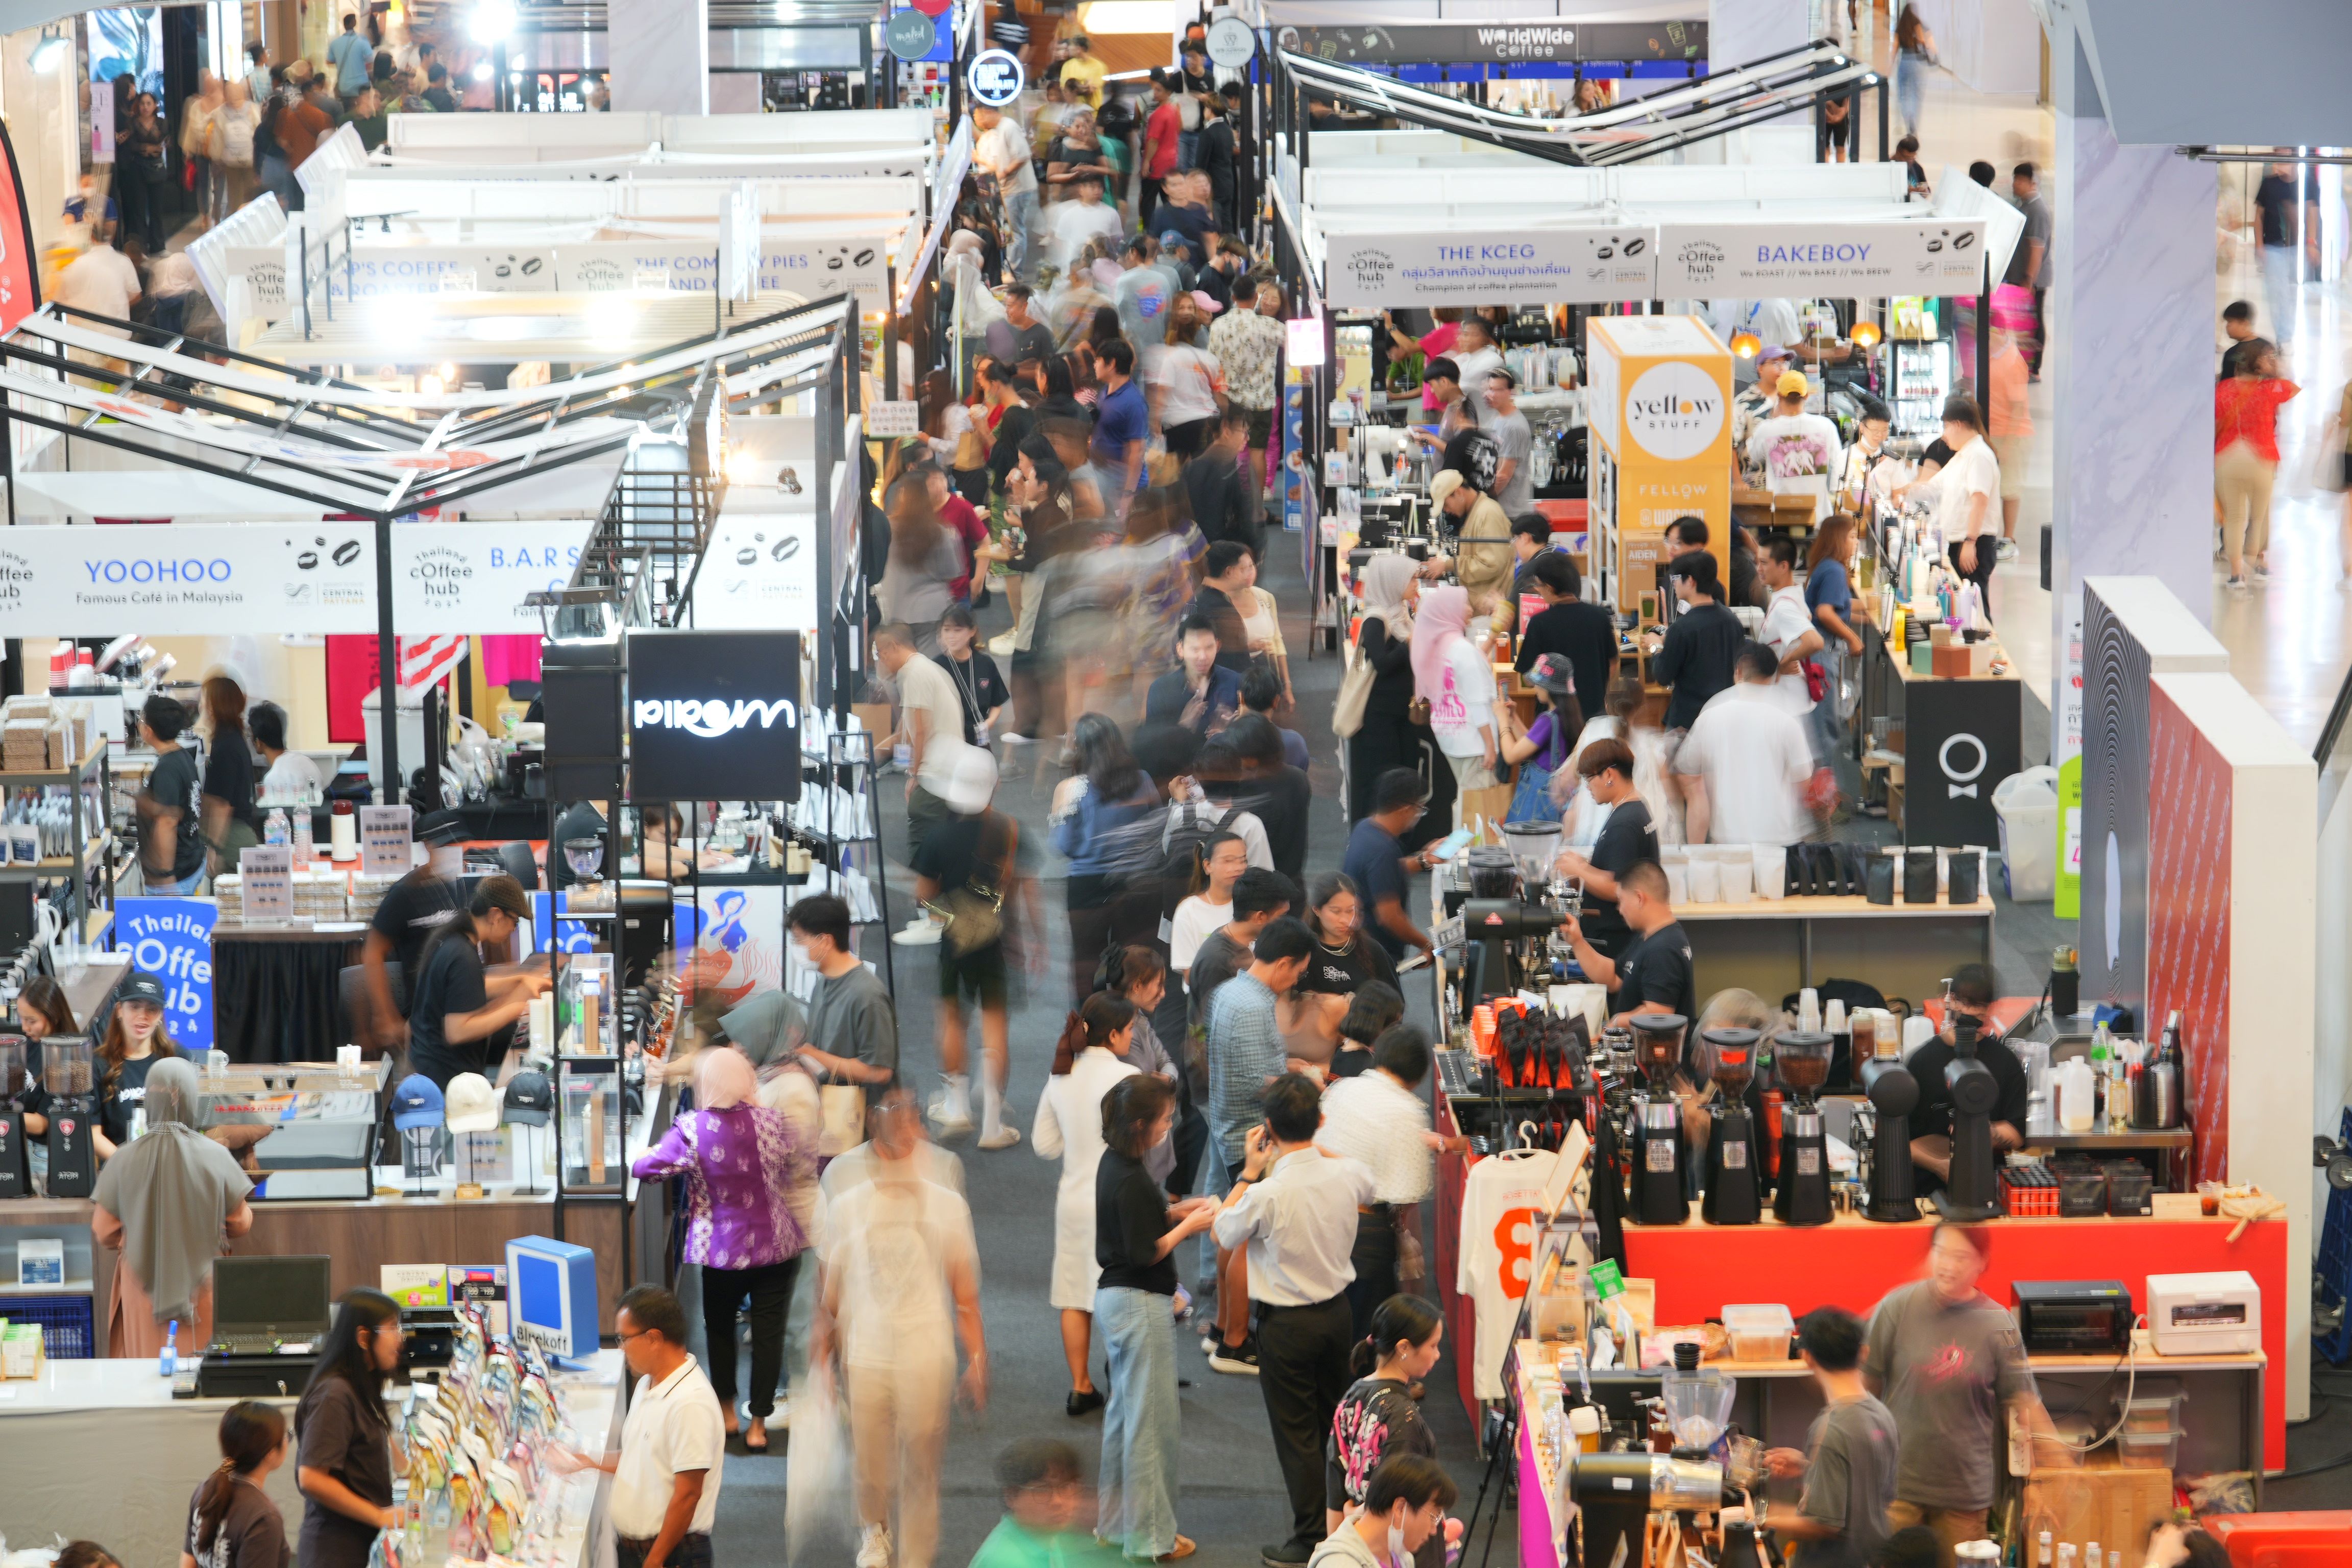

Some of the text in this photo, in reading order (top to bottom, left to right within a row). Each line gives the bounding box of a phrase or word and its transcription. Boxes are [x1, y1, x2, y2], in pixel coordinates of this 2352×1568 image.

[1438, 244, 1535, 261] THE KCEG
[1757, 243, 1872, 264] BAKEBOY
[773, 254, 808, 270] PIES
[1688, 262, 1713, 274] hub
[247, 272, 284, 285] cOffe
[1358, 270, 1384, 283] hub
[1814, 268, 1836, 278] BAKE
[1867, 268, 1892, 278] BREW
[258, 284, 284, 296] hub
[669, 277, 707, 290] AND
[1415, 281, 1557, 295] Champion of coffee plantation
[1632, 393, 1717, 420] yellow
[1649, 420, 1701, 430] STUFF
[1639, 484, 1707, 500] FELLOW
[414, 546, 468, 565] Thailand
[1629, 550, 1658, 561] AIDEN
[84, 558, 232, 583] YOOHOO
[424, 580, 460, 597] hub
[76, 590, 243, 606] Famous Café in Malaysia
[513, 604, 559, 619] Famou
